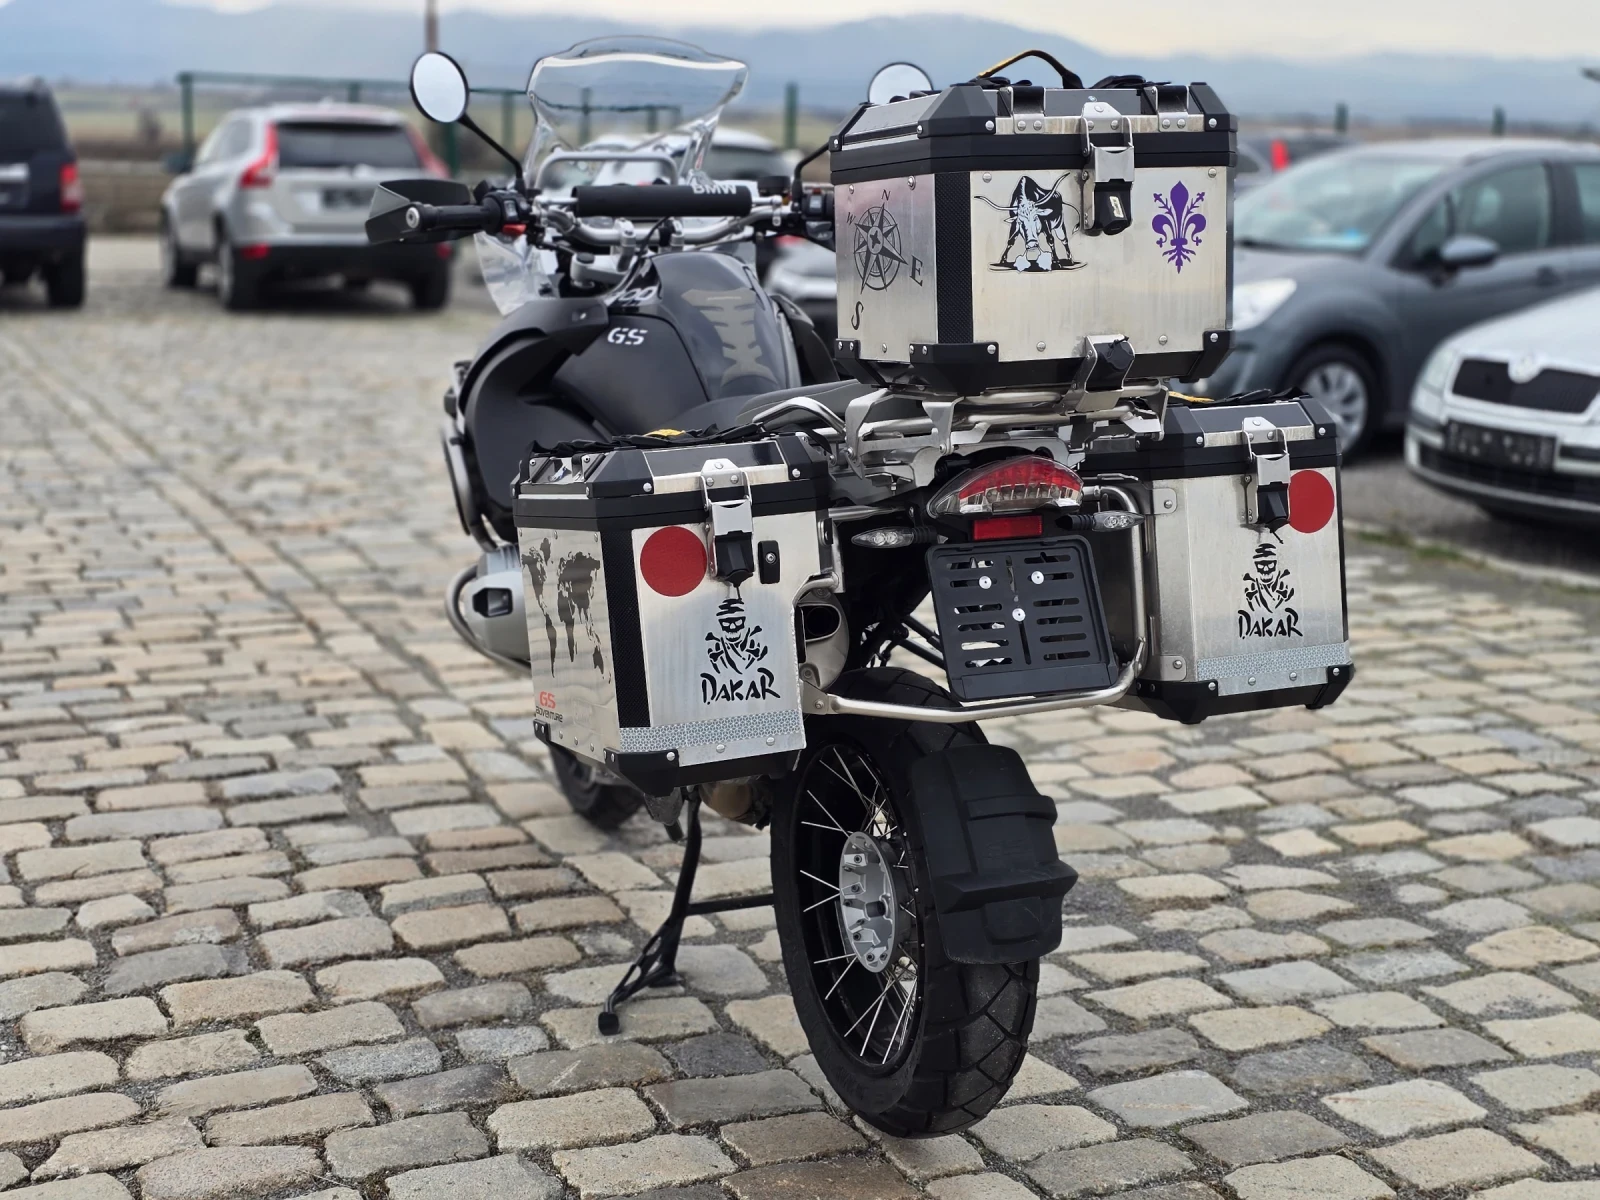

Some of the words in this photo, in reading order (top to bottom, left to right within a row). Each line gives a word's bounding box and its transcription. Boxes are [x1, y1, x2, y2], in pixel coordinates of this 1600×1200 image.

[692, 184, 737, 195] BMW
[881, 189, 891, 201] N
[846, 211, 856, 226] W
[909, 255, 923, 287] E
[851, 300, 864, 331] S
[607, 327, 648, 345] GS
[1237, 607, 1303, 640] DAKAR
[700, 667, 781, 706] DAKAR
[539, 691, 556, 709] GS
